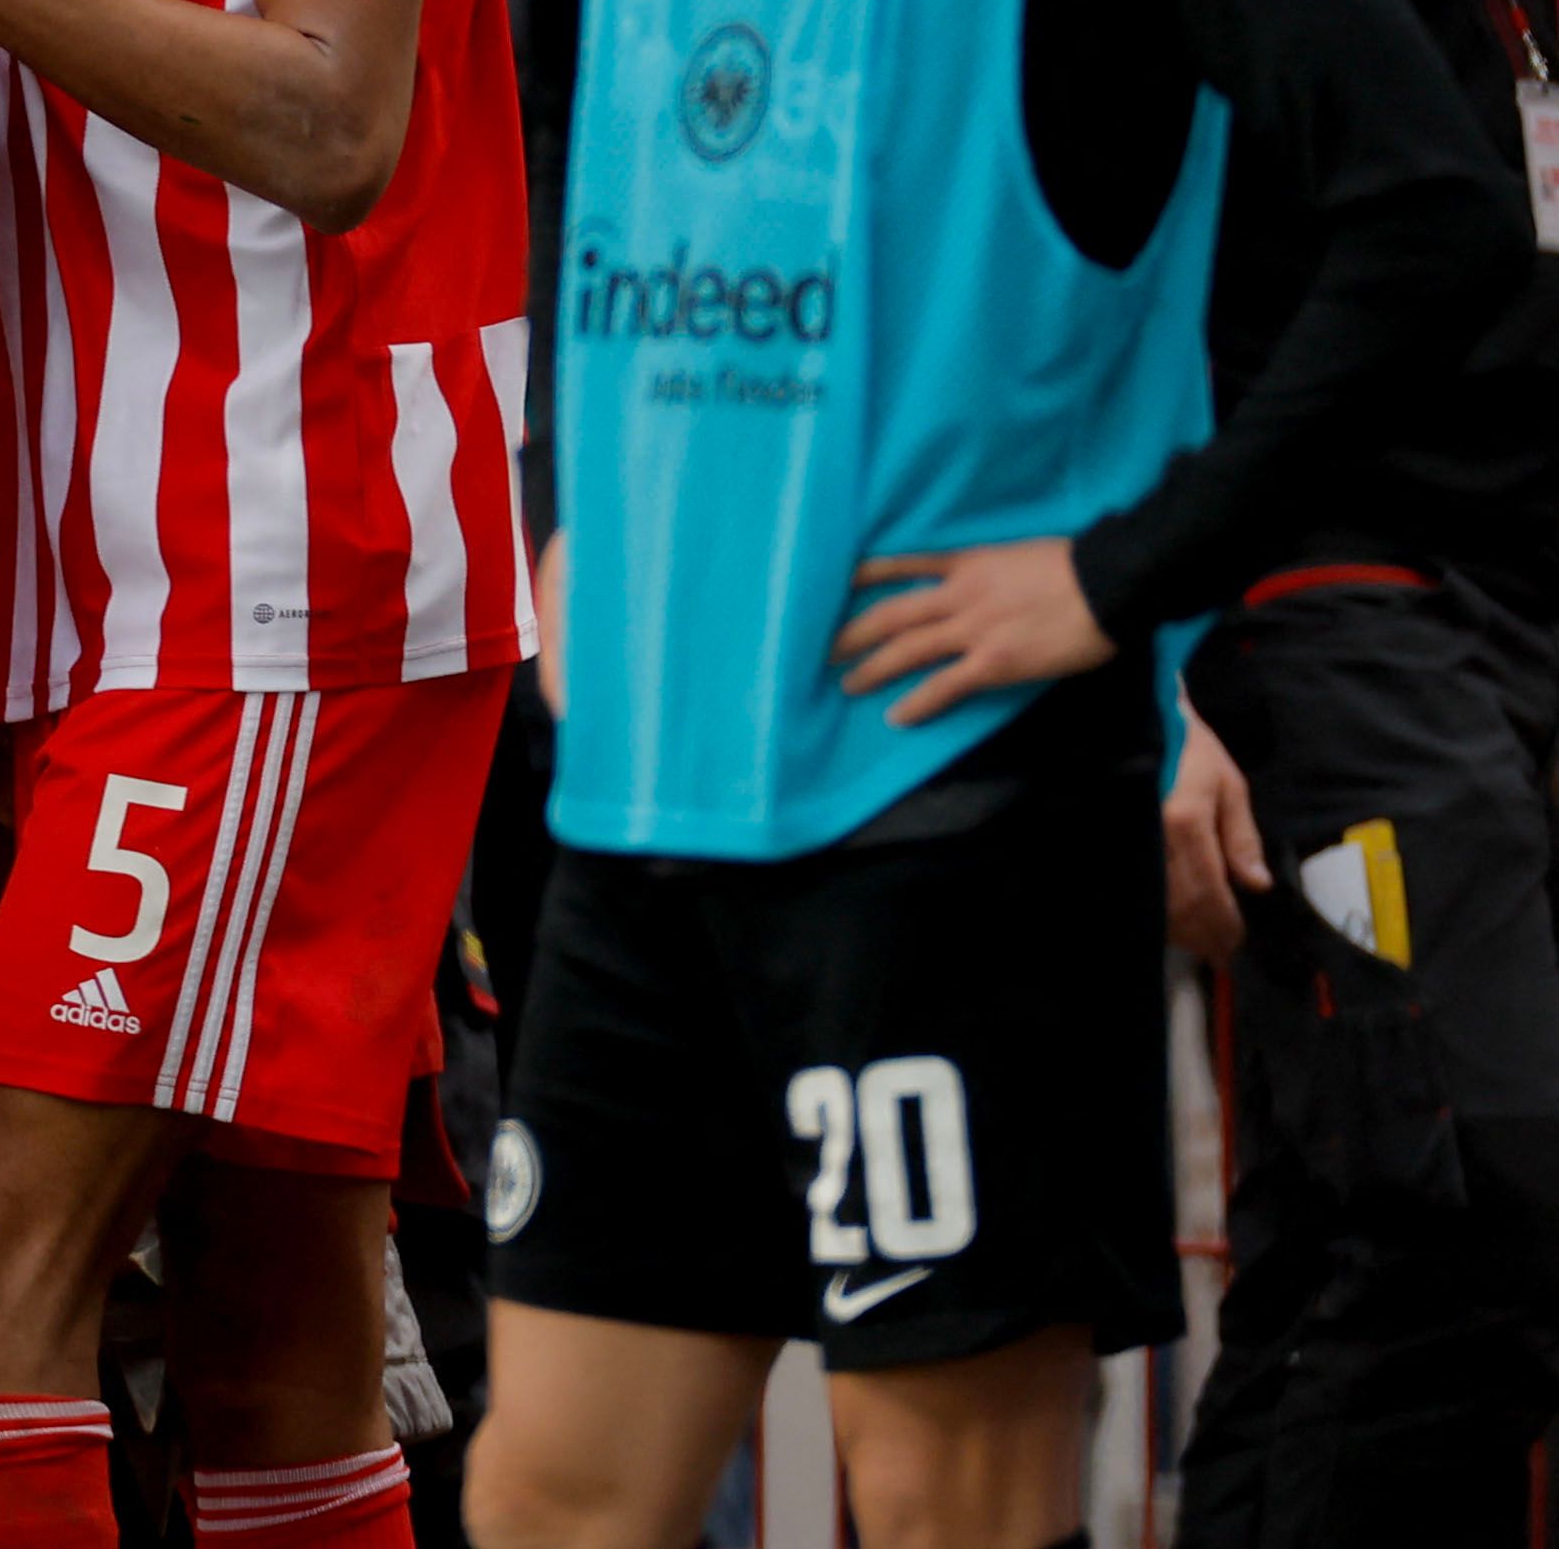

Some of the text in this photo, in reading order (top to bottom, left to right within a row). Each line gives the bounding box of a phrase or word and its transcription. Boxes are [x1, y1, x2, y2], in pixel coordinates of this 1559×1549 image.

[576, 237, 842, 342] indeed
[68, 773, 188, 963] 5
[50, 1002, 141, 1034] adidas
[785, 1054, 978, 1266] 20
